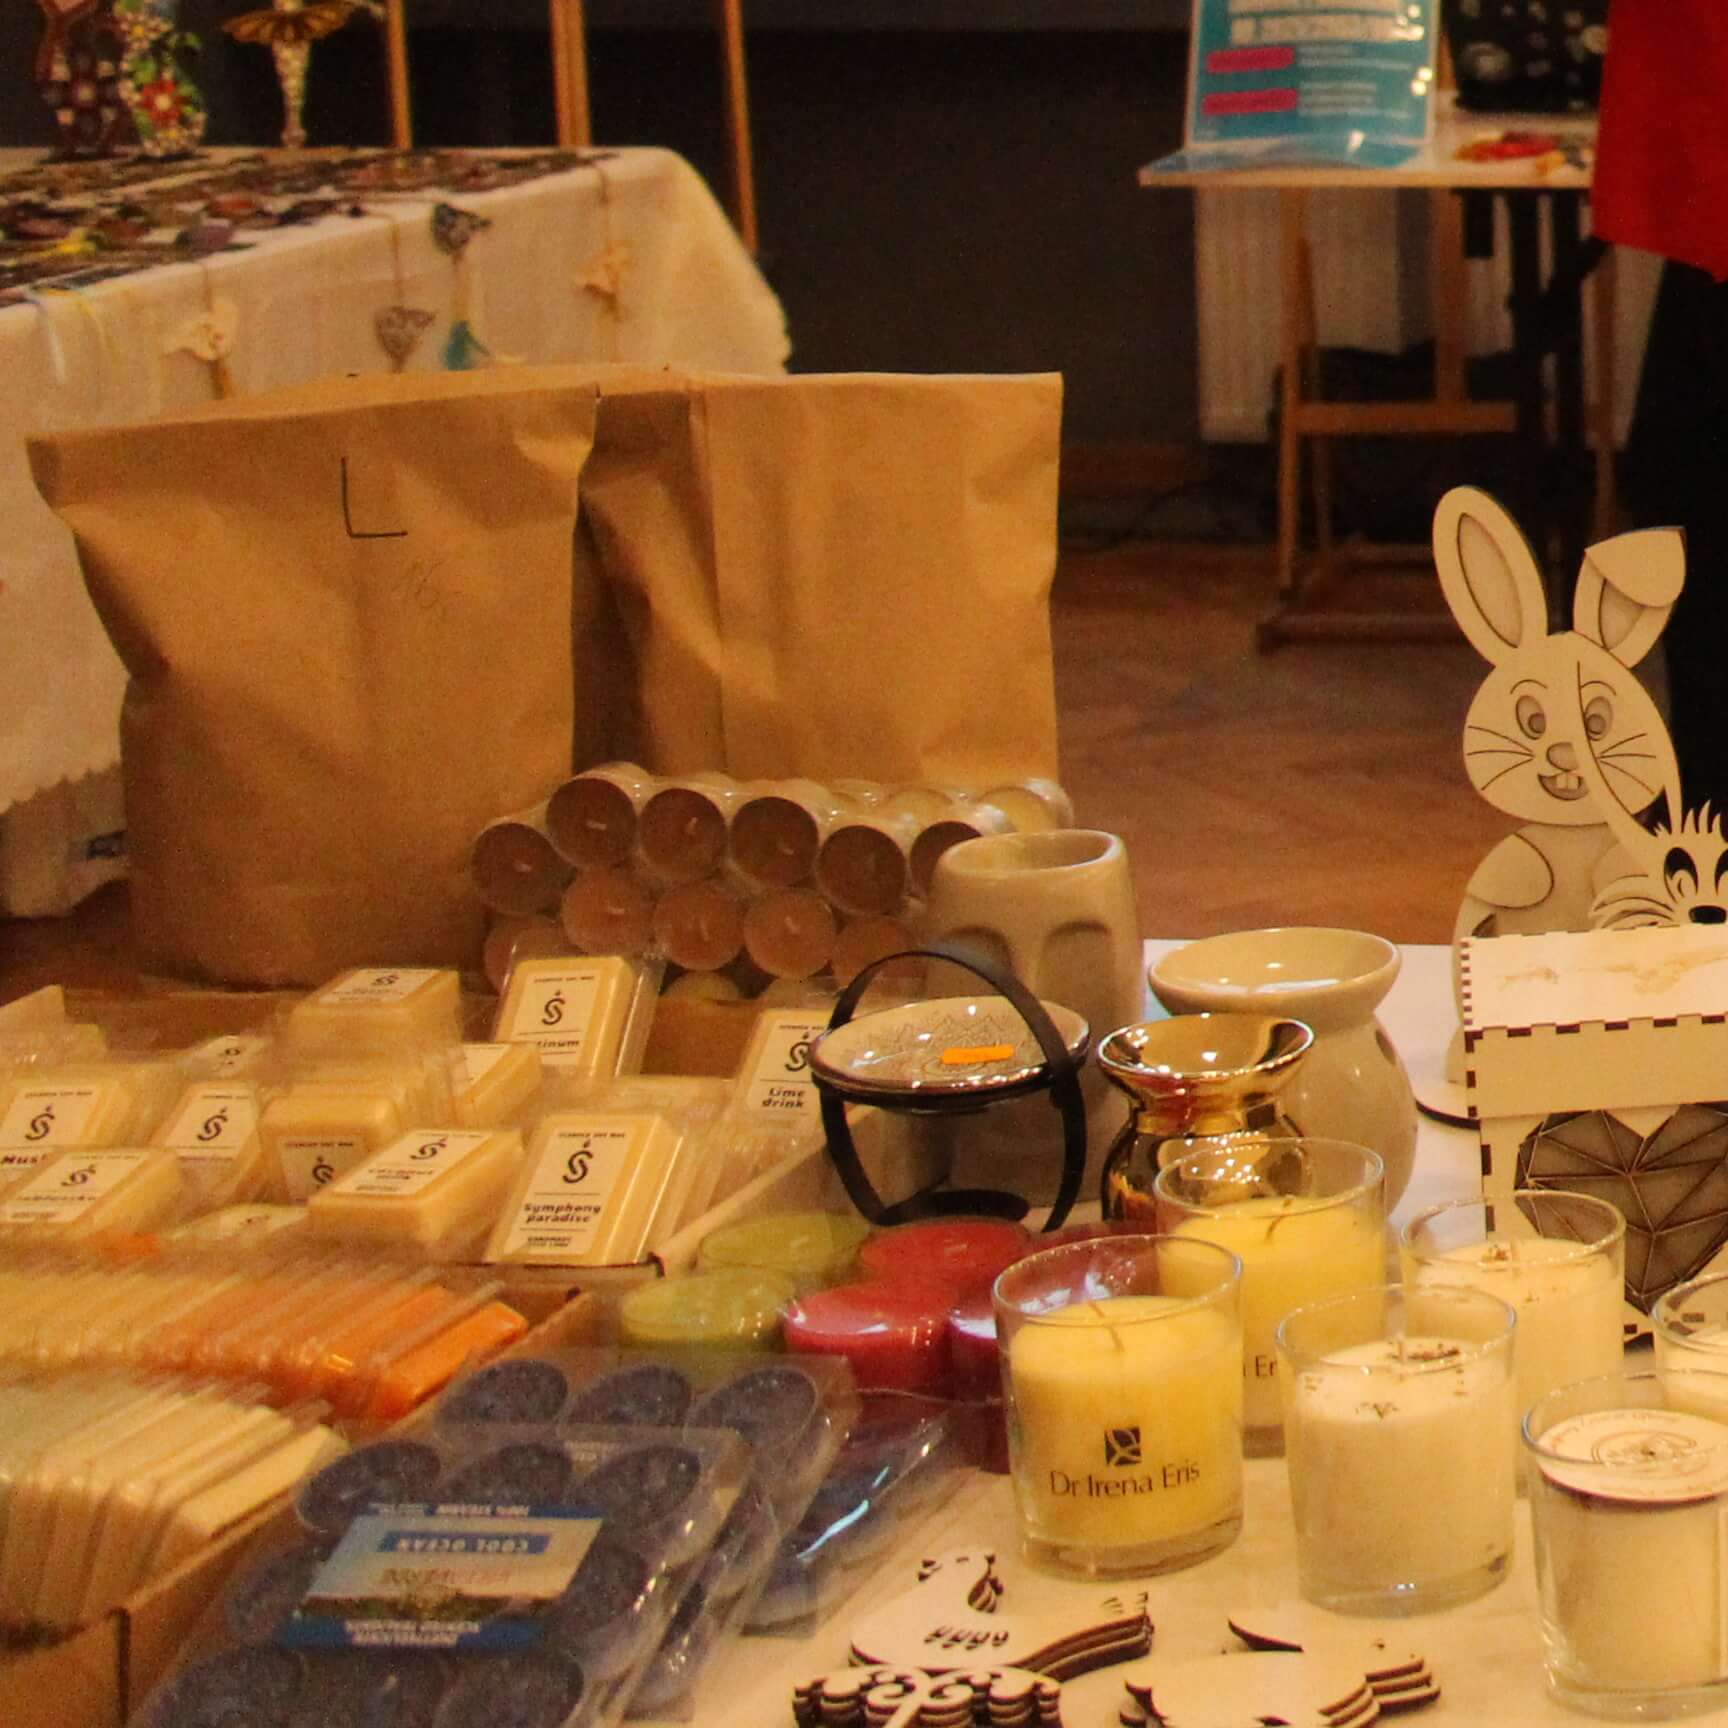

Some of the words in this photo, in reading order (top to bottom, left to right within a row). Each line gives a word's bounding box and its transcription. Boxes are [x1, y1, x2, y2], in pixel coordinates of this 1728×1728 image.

[1050, 1470, 1080, 1498] Dr
[1088, 1473, 1154, 1498] Irena
[1161, 1459, 1200, 1489] Eris
